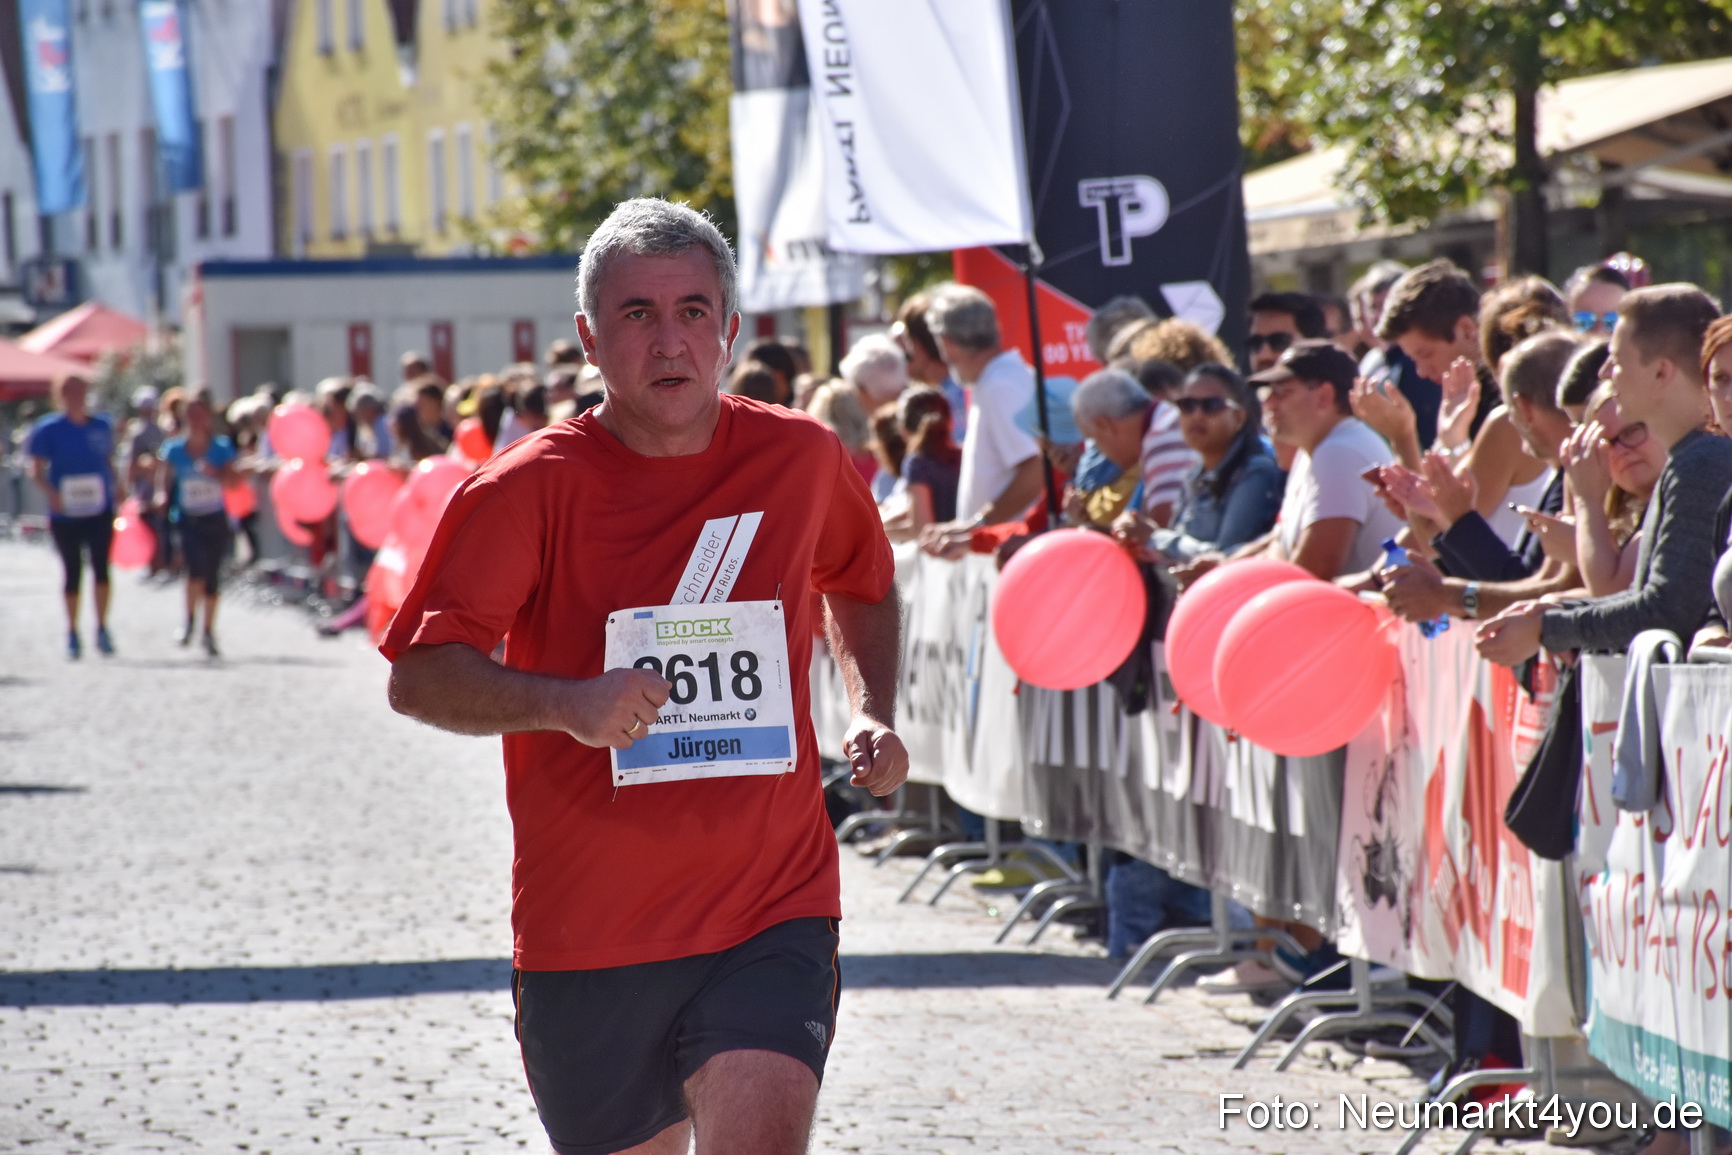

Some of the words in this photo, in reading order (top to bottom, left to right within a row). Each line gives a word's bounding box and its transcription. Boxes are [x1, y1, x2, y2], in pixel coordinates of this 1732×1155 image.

[680, 531, 721, 604] chneider
[711, 587, 724, 603] nd
[718, 557, 740, 588] Autos.
[656, 618, 733, 639] BOCK
[633, 650, 762, 705] 618
[655, 714, 687, 725] ARTL
[689, 710, 741, 723] Neumarkt
[668, 736, 742, 761] Jürgen
